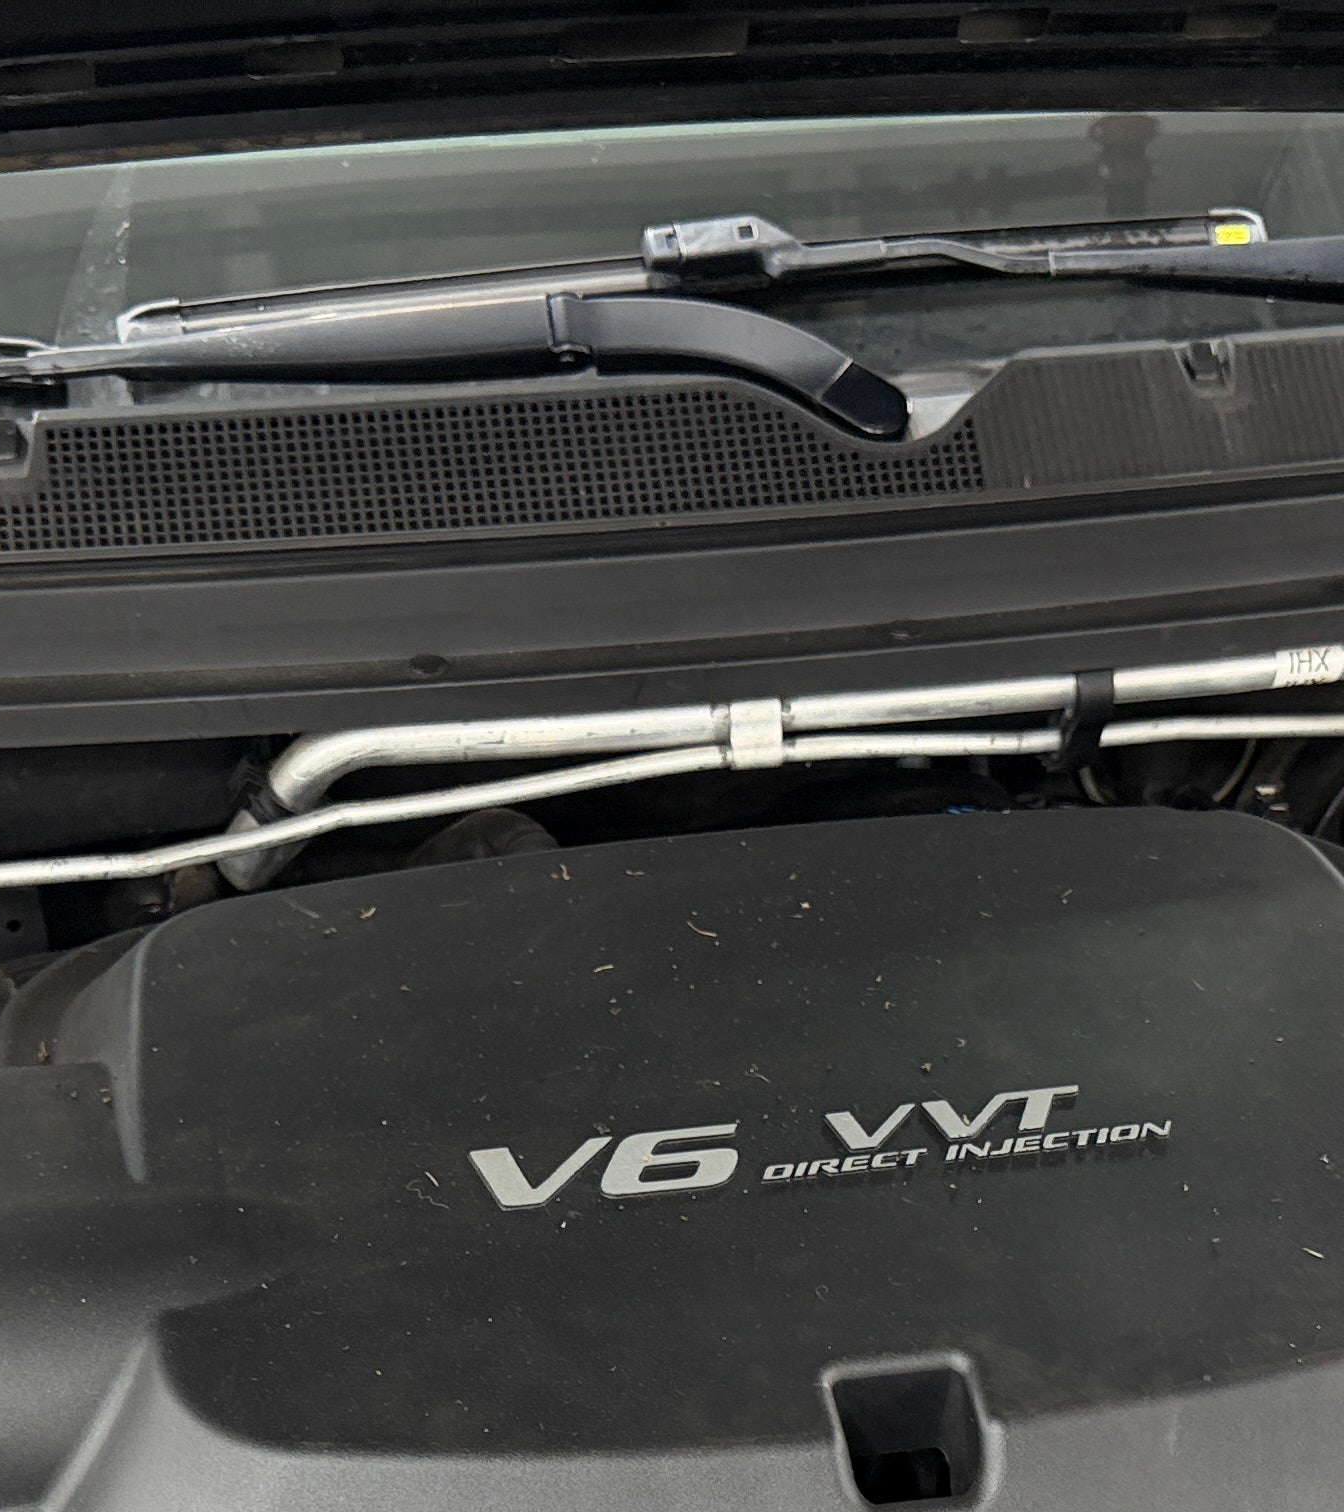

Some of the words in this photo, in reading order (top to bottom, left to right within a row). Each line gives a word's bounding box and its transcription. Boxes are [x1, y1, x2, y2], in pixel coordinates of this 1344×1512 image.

[1289, 647, 1329, 674] IHX
[825, 1084, 1079, 1152] VVT
[469, 1123, 737, 1210] V6
[761, 1147, 927, 1183] DIRECT
[944, 1121, 1172, 1162] INJECTION
